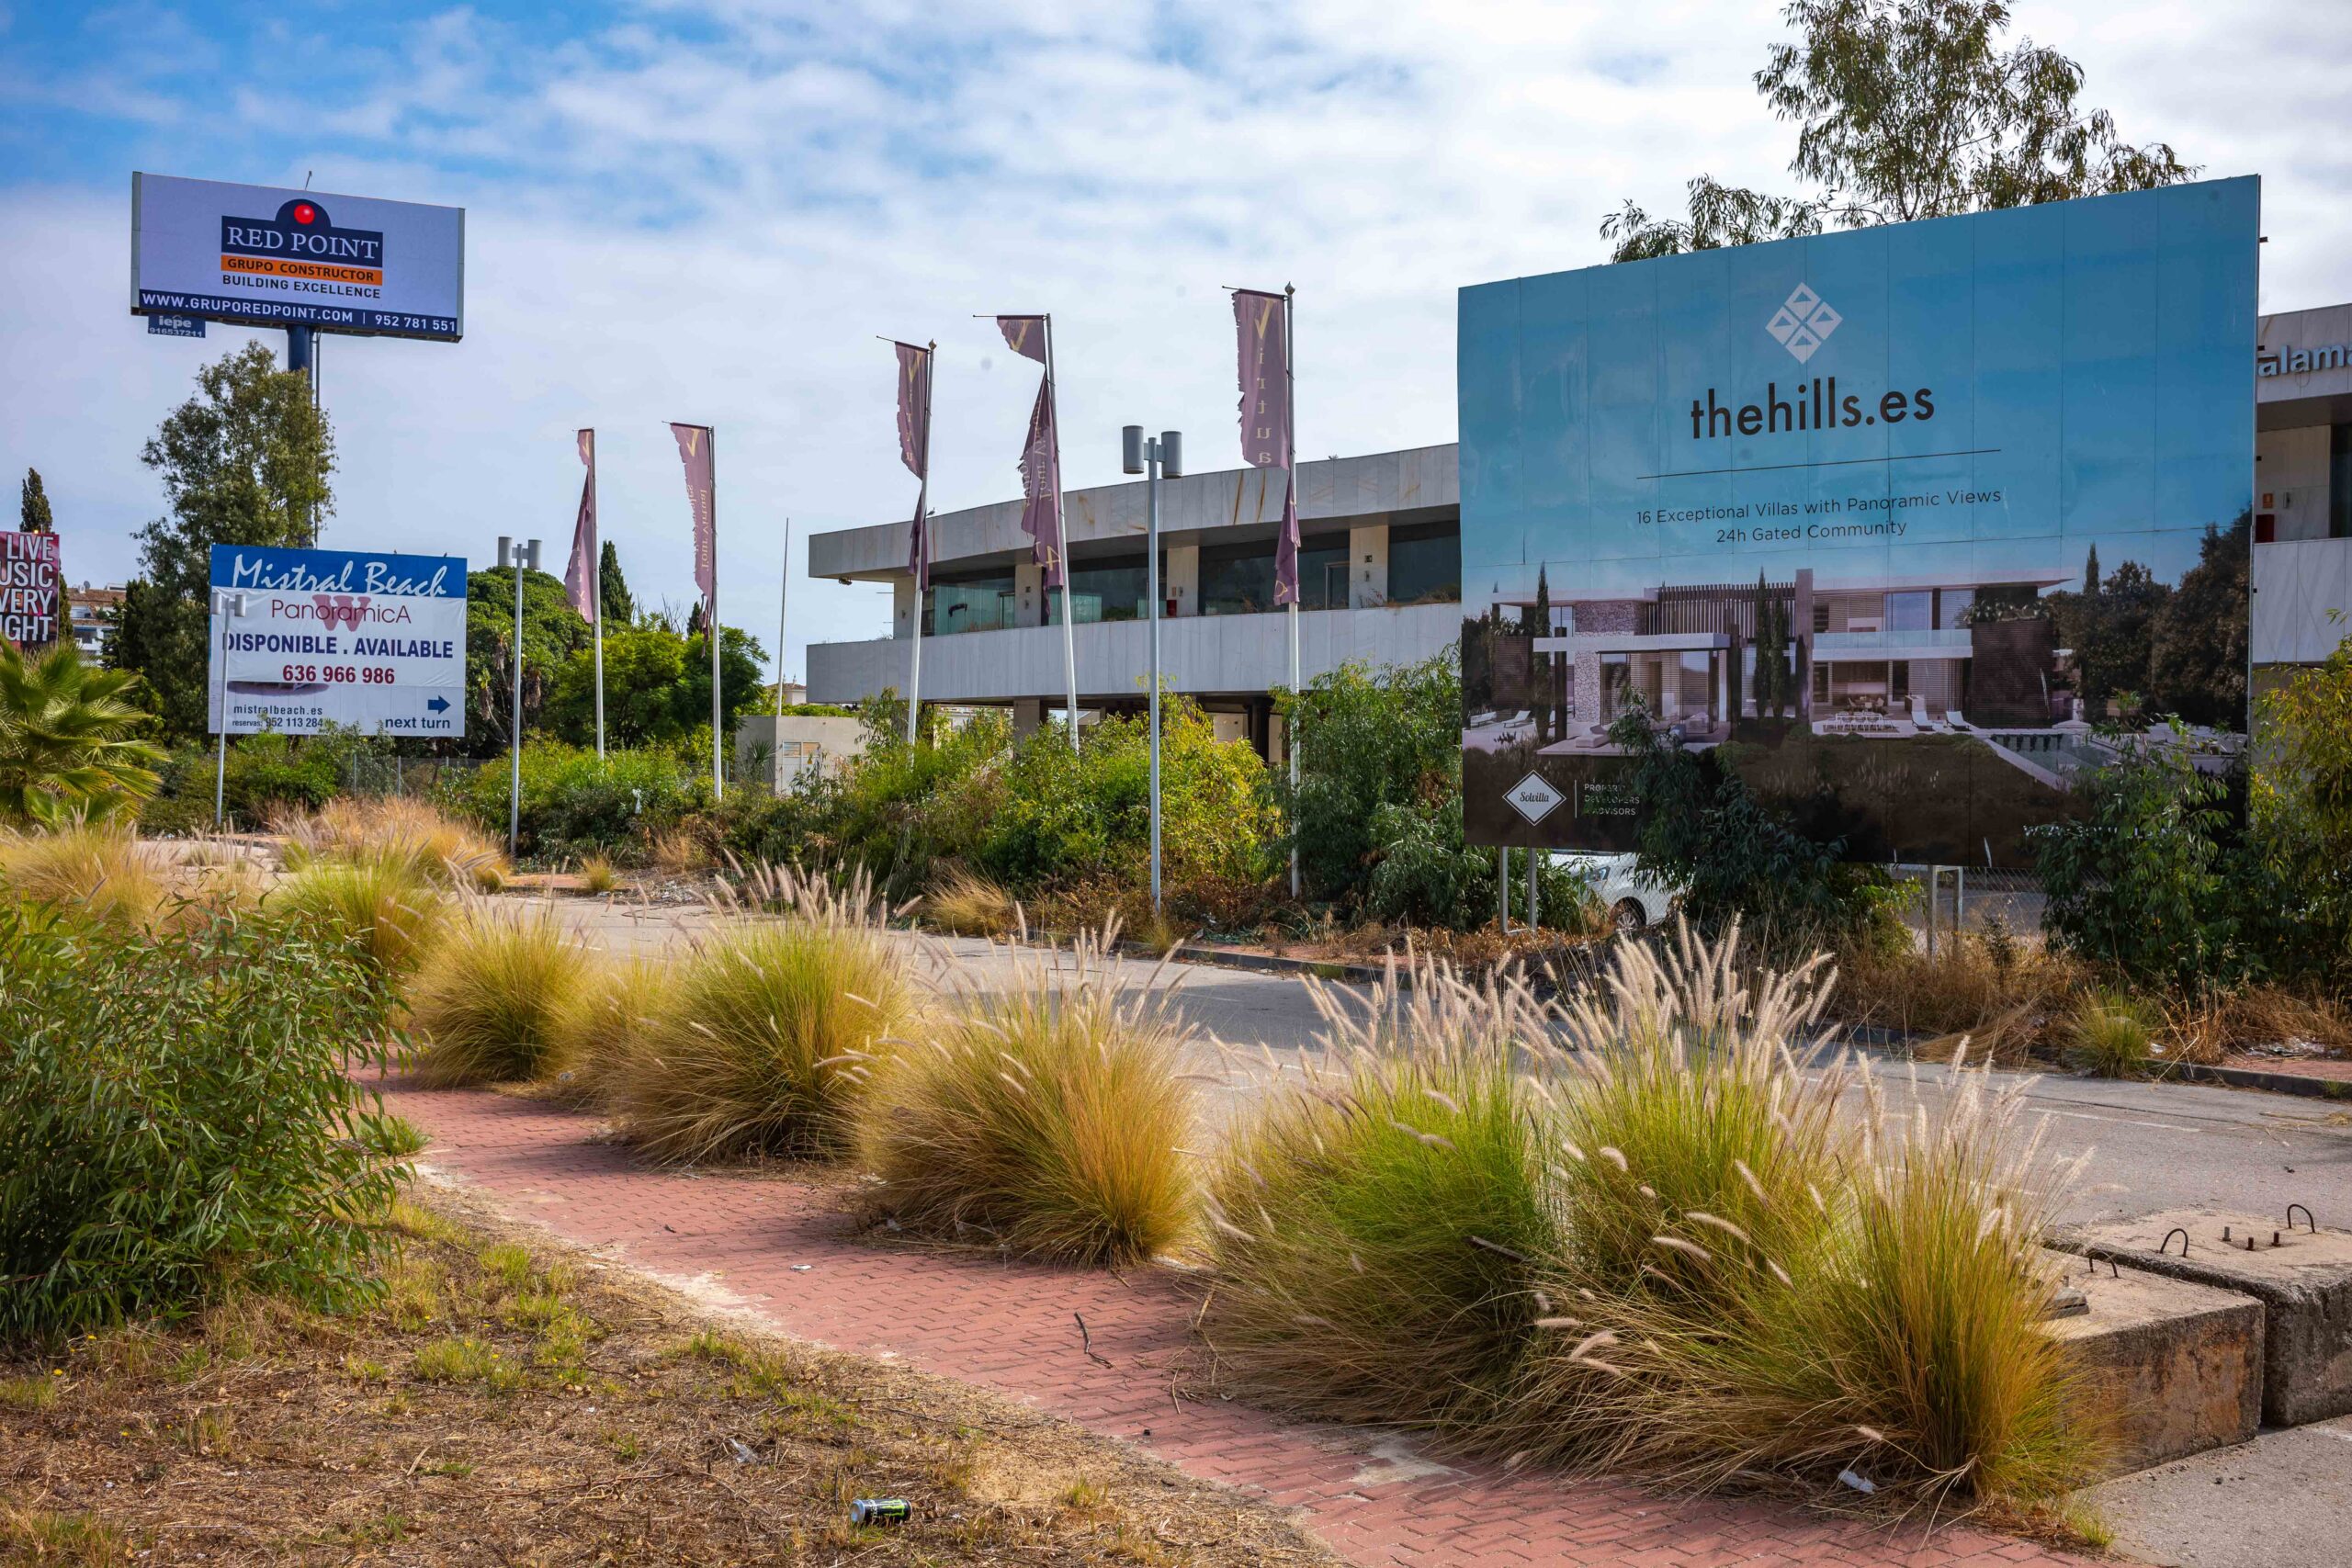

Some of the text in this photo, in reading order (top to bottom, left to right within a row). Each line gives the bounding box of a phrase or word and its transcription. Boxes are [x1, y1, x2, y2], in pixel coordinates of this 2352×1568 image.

[227, 225, 379, 260] RED POINT
[227, 258, 375, 281] GRUPO CONSTRUCTOR
[222, 275, 381, 299] BUILDING EXCELLENCE
[141, 293, 456, 332] WWW.GRUPOREDPOINT.COM 952 781 551
[2257, 344, 2352, 377] alam
[1690, 377, 1935, 439] thehills.es
[1636, 489, 2001, 525] 16 Exceptional Villas with Panoramic Views
[1716, 520, 1907, 543] 24h Gated Community
[6, 534, 54, 561] LIVE
[232, 554, 448, 597] Mistral Beach
[271, 599, 412, 625] PanoramicA
[222, 633, 454, 659] DISPONIBLE AVAILABLE
[282, 664, 395, 684] 636 966 986
[233, 705, 323, 716] mistralbeach.es
[285, 717, 303, 728] 113
[305, 717, 323, 728] 284
[384, 716, 451, 729] next turn
